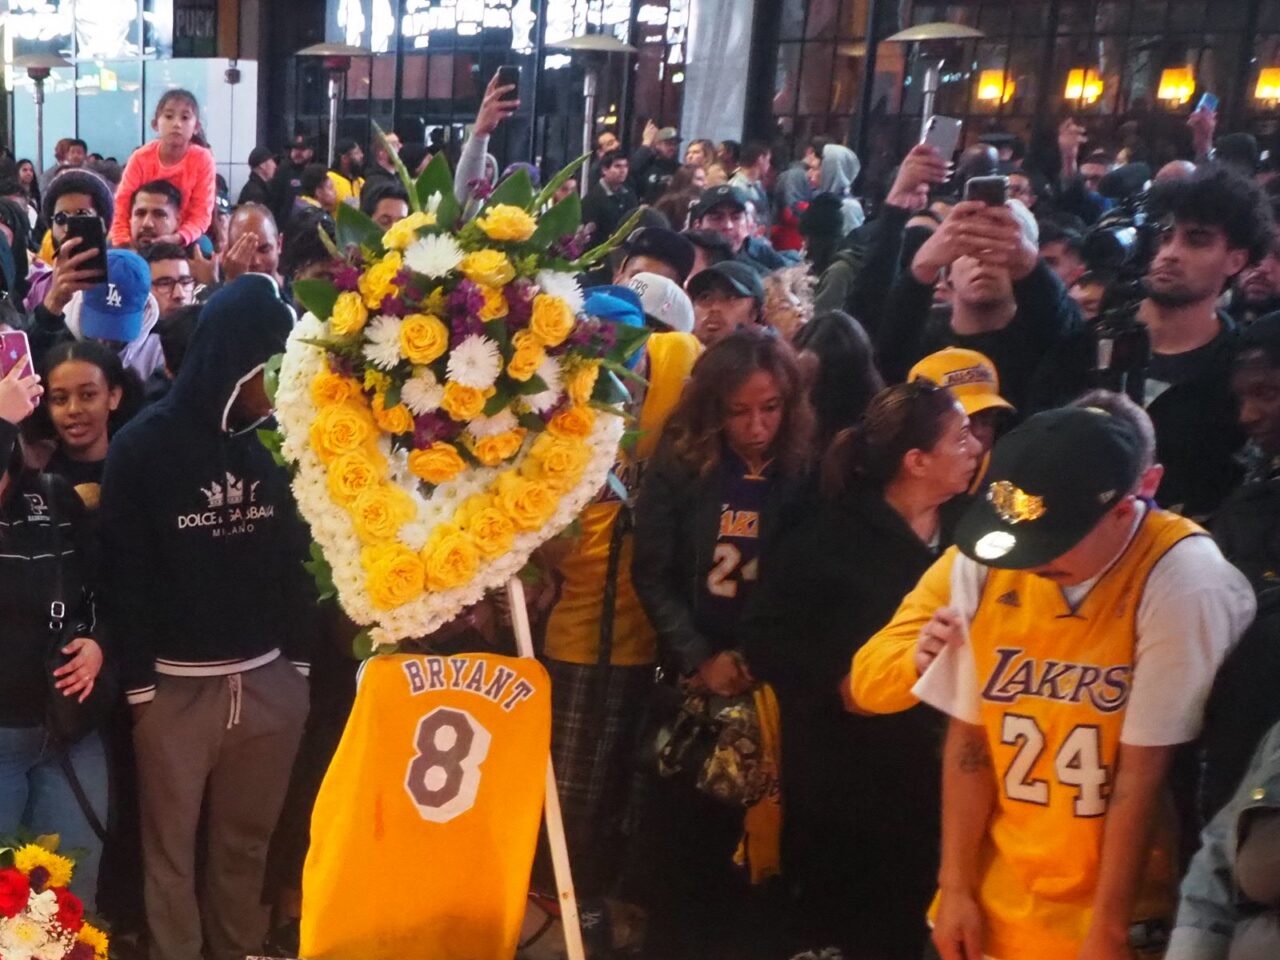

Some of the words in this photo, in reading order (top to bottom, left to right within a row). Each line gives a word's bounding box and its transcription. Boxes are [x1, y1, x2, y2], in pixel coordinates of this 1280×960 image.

[106, 283, 122, 307] LA
[177, 513, 217, 529] DOLCE
[401, 656, 536, 713] BRYANT
[404, 705, 492, 823] 8
[1001, 712, 1111, 818] 24
